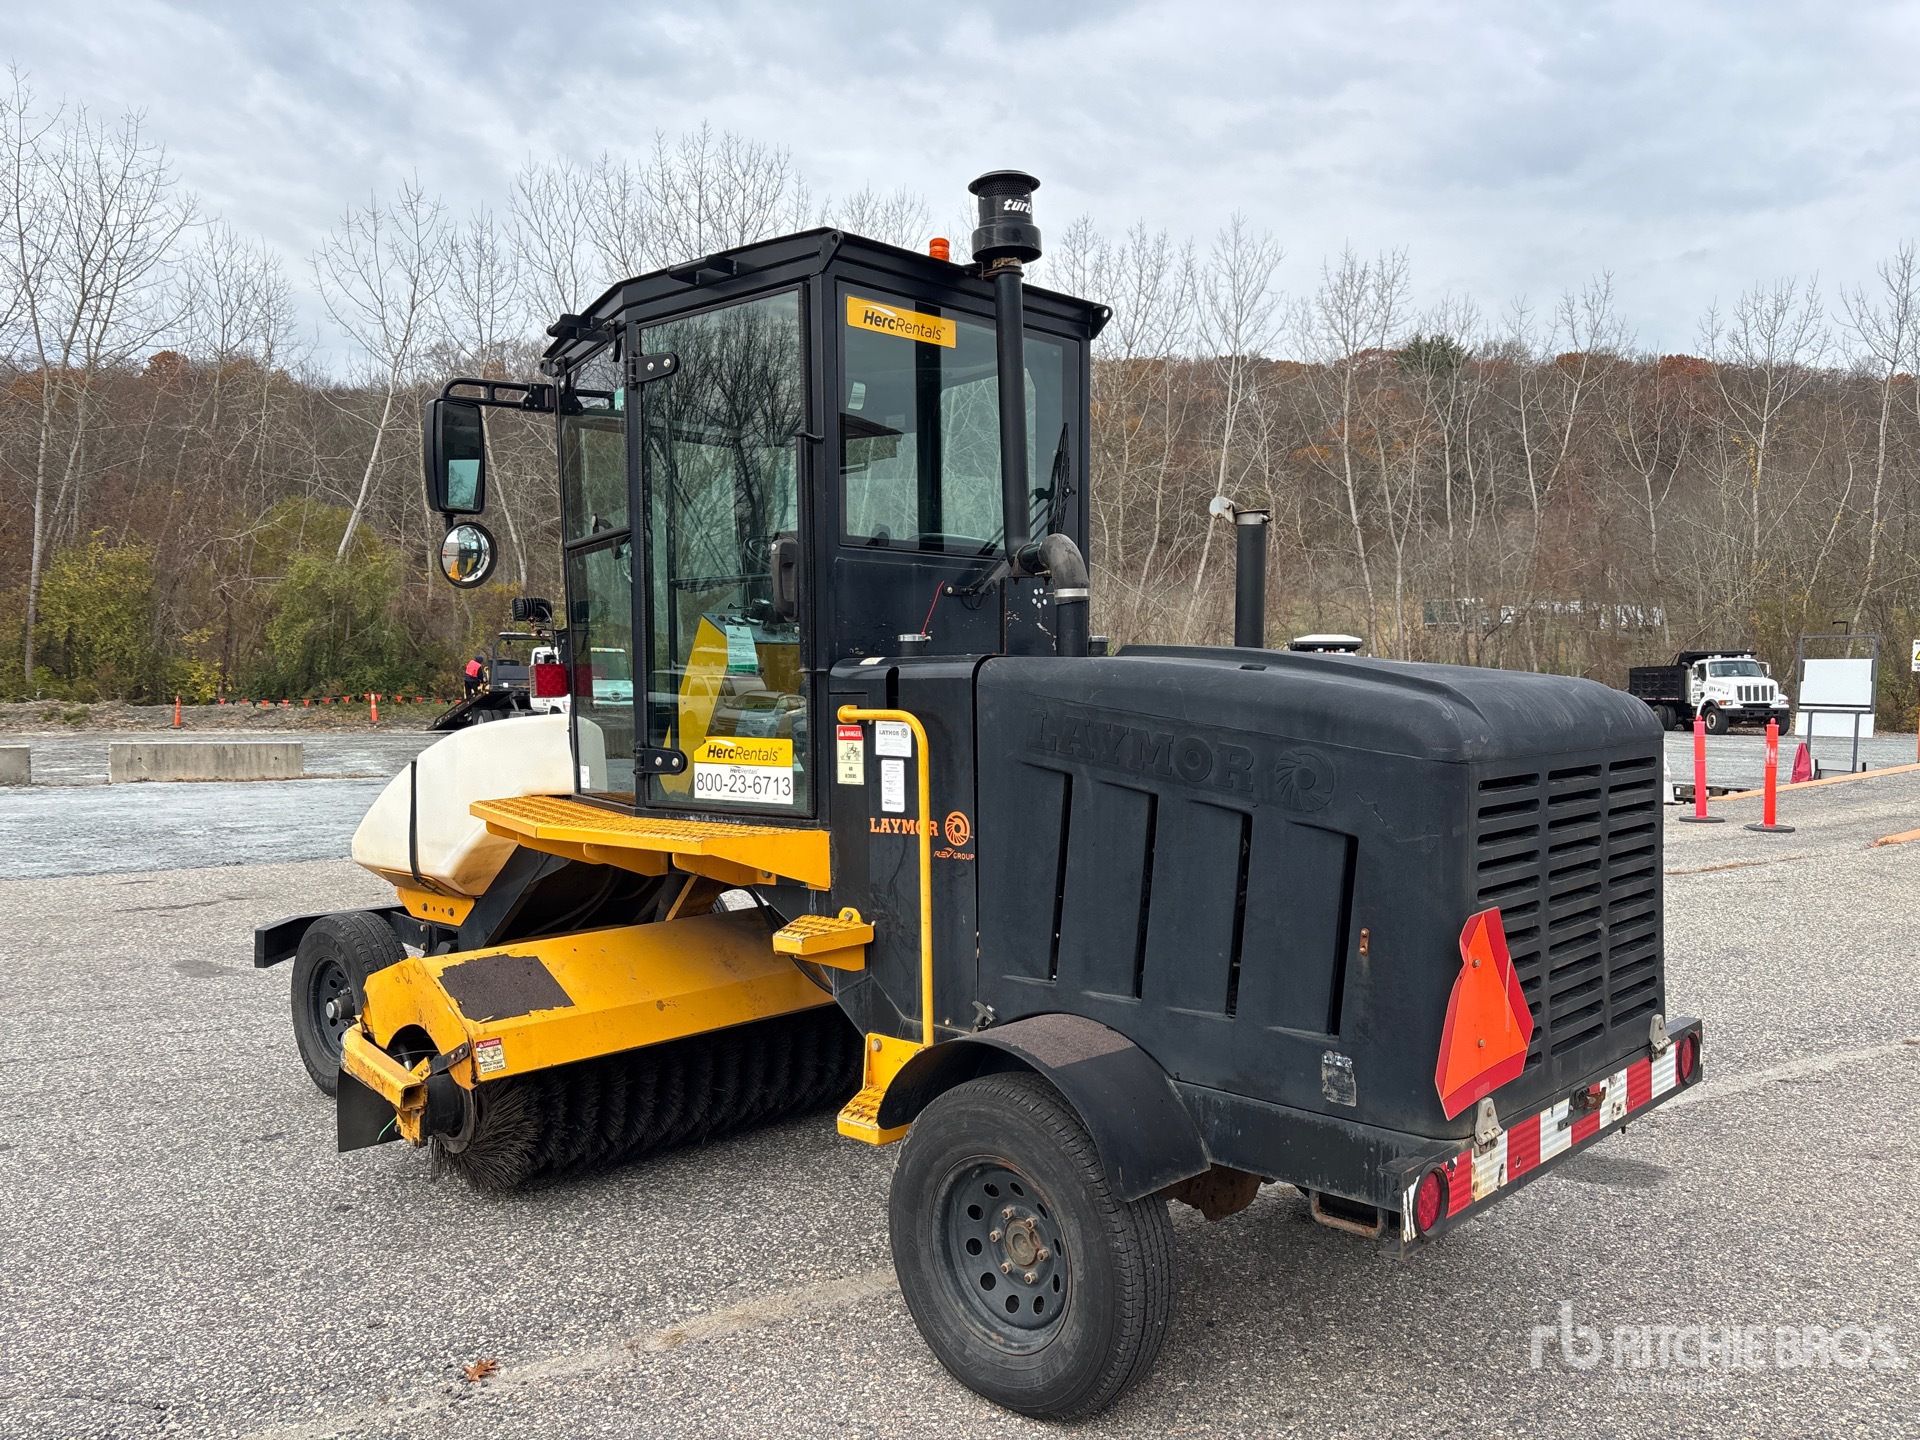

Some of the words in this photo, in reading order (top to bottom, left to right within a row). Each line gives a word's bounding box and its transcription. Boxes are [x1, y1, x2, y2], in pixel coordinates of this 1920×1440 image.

[863, 310, 942, 340] HercRentals
[707, 745, 778, 762] HercRentals
[1029, 708, 1254, 792] LAYMOR
[696, 772, 791, 796] 800-23-6713
[953, 852, 975, 861] GROUP
